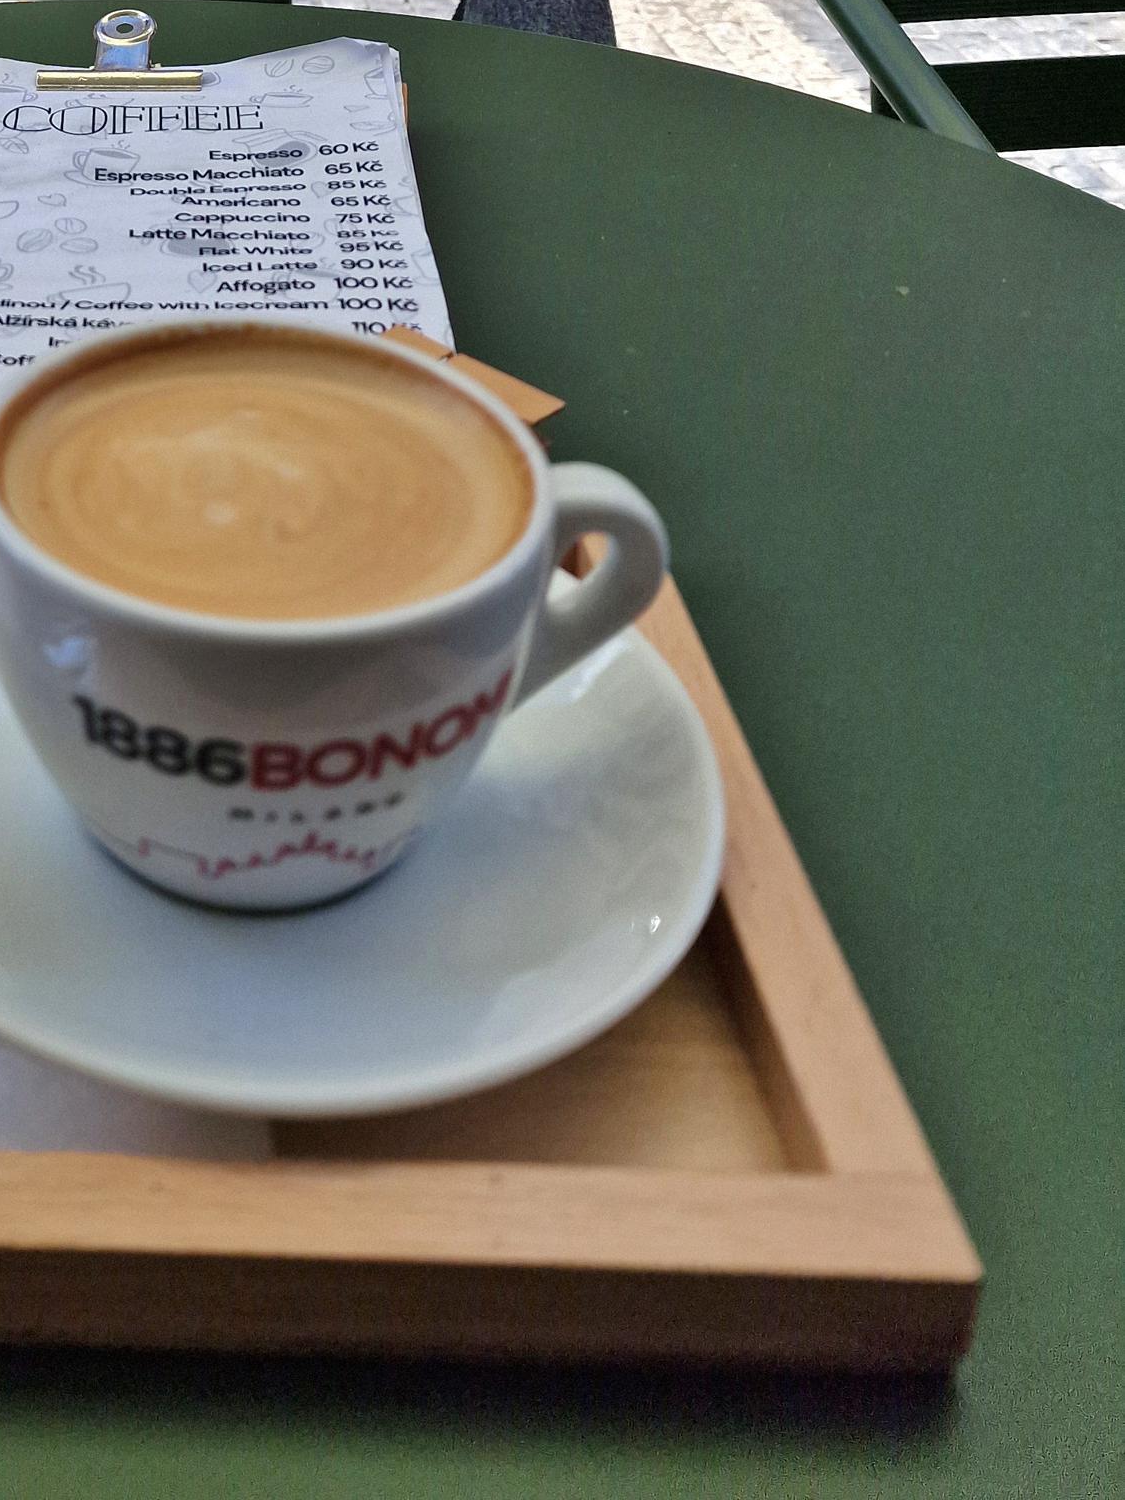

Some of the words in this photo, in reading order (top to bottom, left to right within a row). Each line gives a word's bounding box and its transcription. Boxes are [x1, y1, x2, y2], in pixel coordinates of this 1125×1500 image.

[2, 104, 264, 136] COFFEE
[208, 149, 303, 163] Espresso
[318, 143, 349, 156] 60
[352, 140, 380, 153] Kč
[94, 167, 189, 183] Espresso
[192, 163, 305, 181] Macchiato
[324, 162, 353, 175] 65
[356, 160, 383, 173] Kč
[327, 179, 356, 191] 85
[180, 194, 301, 207] Americano
[330, 195, 360, 207] 65
[363, 194, 391, 207] Kč
[174, 212, 311, 227] Cappuccino
[335, 212, 363, 224] 75
[366, 213, 395, 224] Kč
[129, 228, 187, 241] Latte
[191, 227, 311, 241] Macchiato
[198, 246, 238, 256] Flat
[244, 246, 313, 255] White
[339, 241, 371, 253] 95
[374, 240, 404, 251] Kč
[202, 261, 253, 273] Iced
[257, 261, 318, 272] Latte
[340, 258, 375, 270] 90
[378, 258, 408, 269] Kč
[216, 279, 316, 295] Affogato
[333, 276, 379, 290] 100
[382, 276, 413, 289] Kč
[74, 300, 154, 310] Coffee
[158, 301, 210, 310] with
[214, 300, 329, 310] Icecream
[336, 297, 383, 310] 100
[387, 298, 419, 313] Kč
